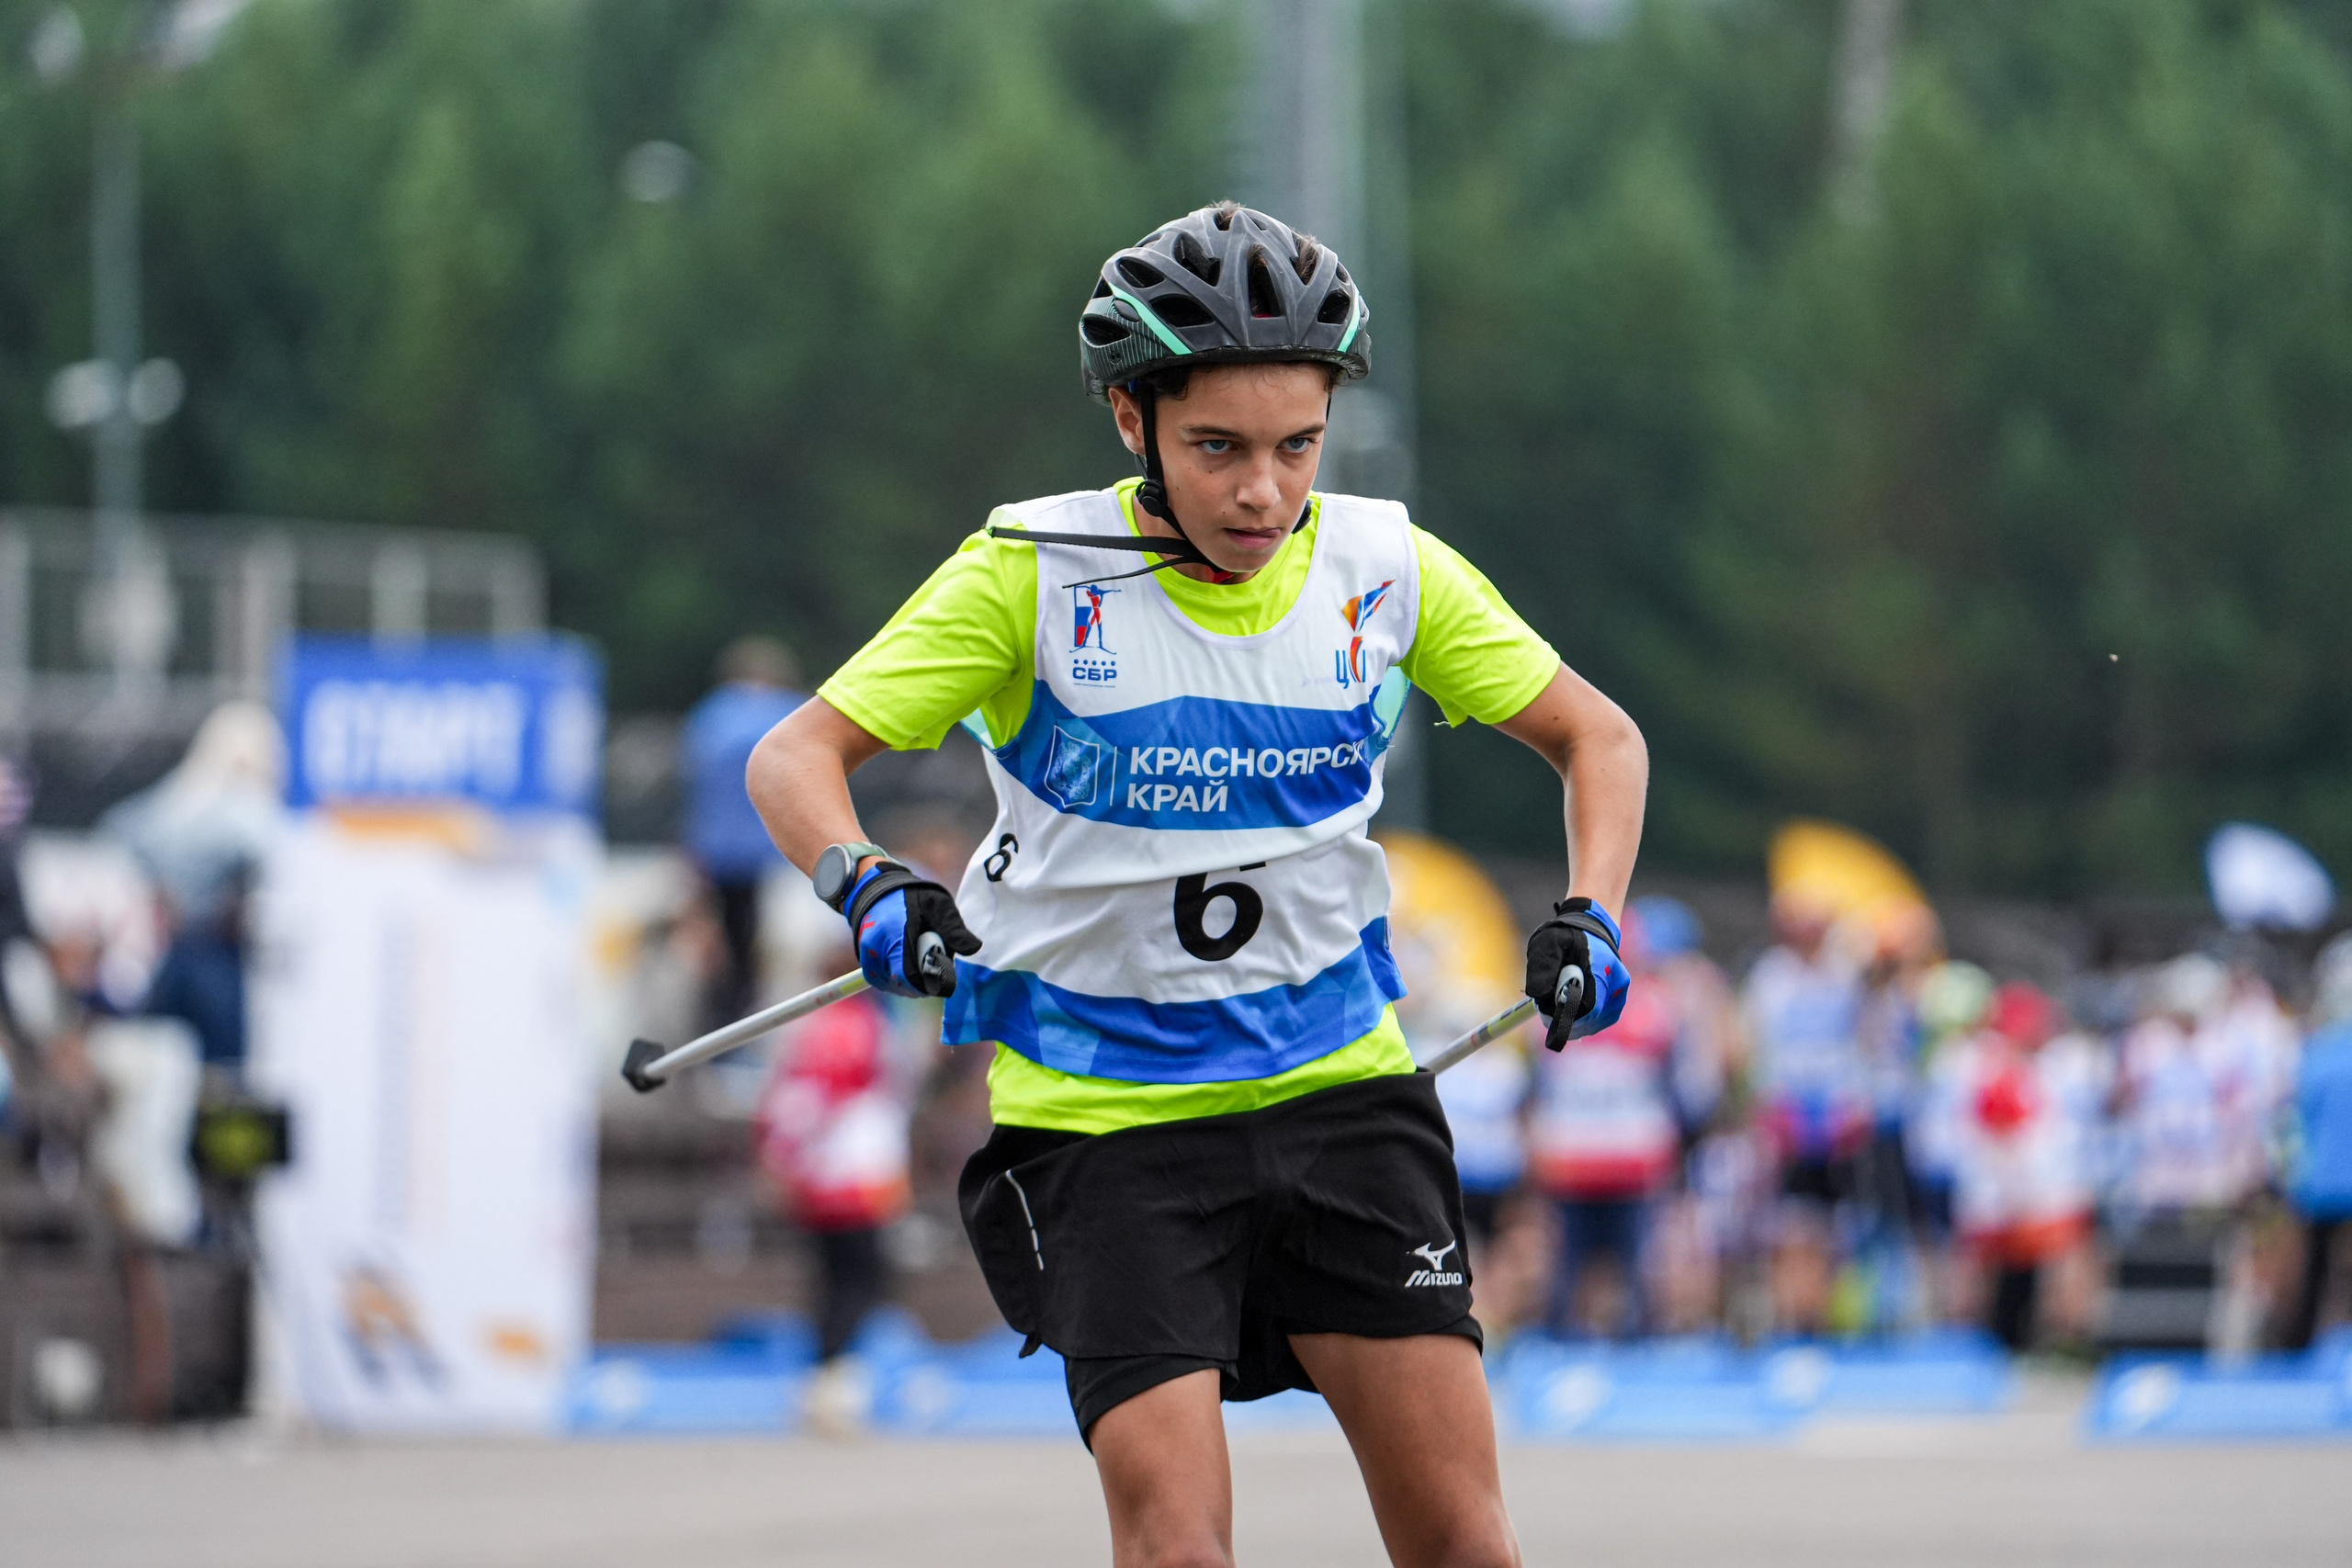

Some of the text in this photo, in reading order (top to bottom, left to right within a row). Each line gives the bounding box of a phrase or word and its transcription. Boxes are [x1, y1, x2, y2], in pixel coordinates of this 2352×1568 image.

[1072, 666, 1118, 682] СБР
[1126, 779, 1229, 813] КРАЙ
[983, 832, 1020, 882] 6
[1173, 861, 1267, 962] 6
[1404, 1269, 1464, 1288] MIZUNO
